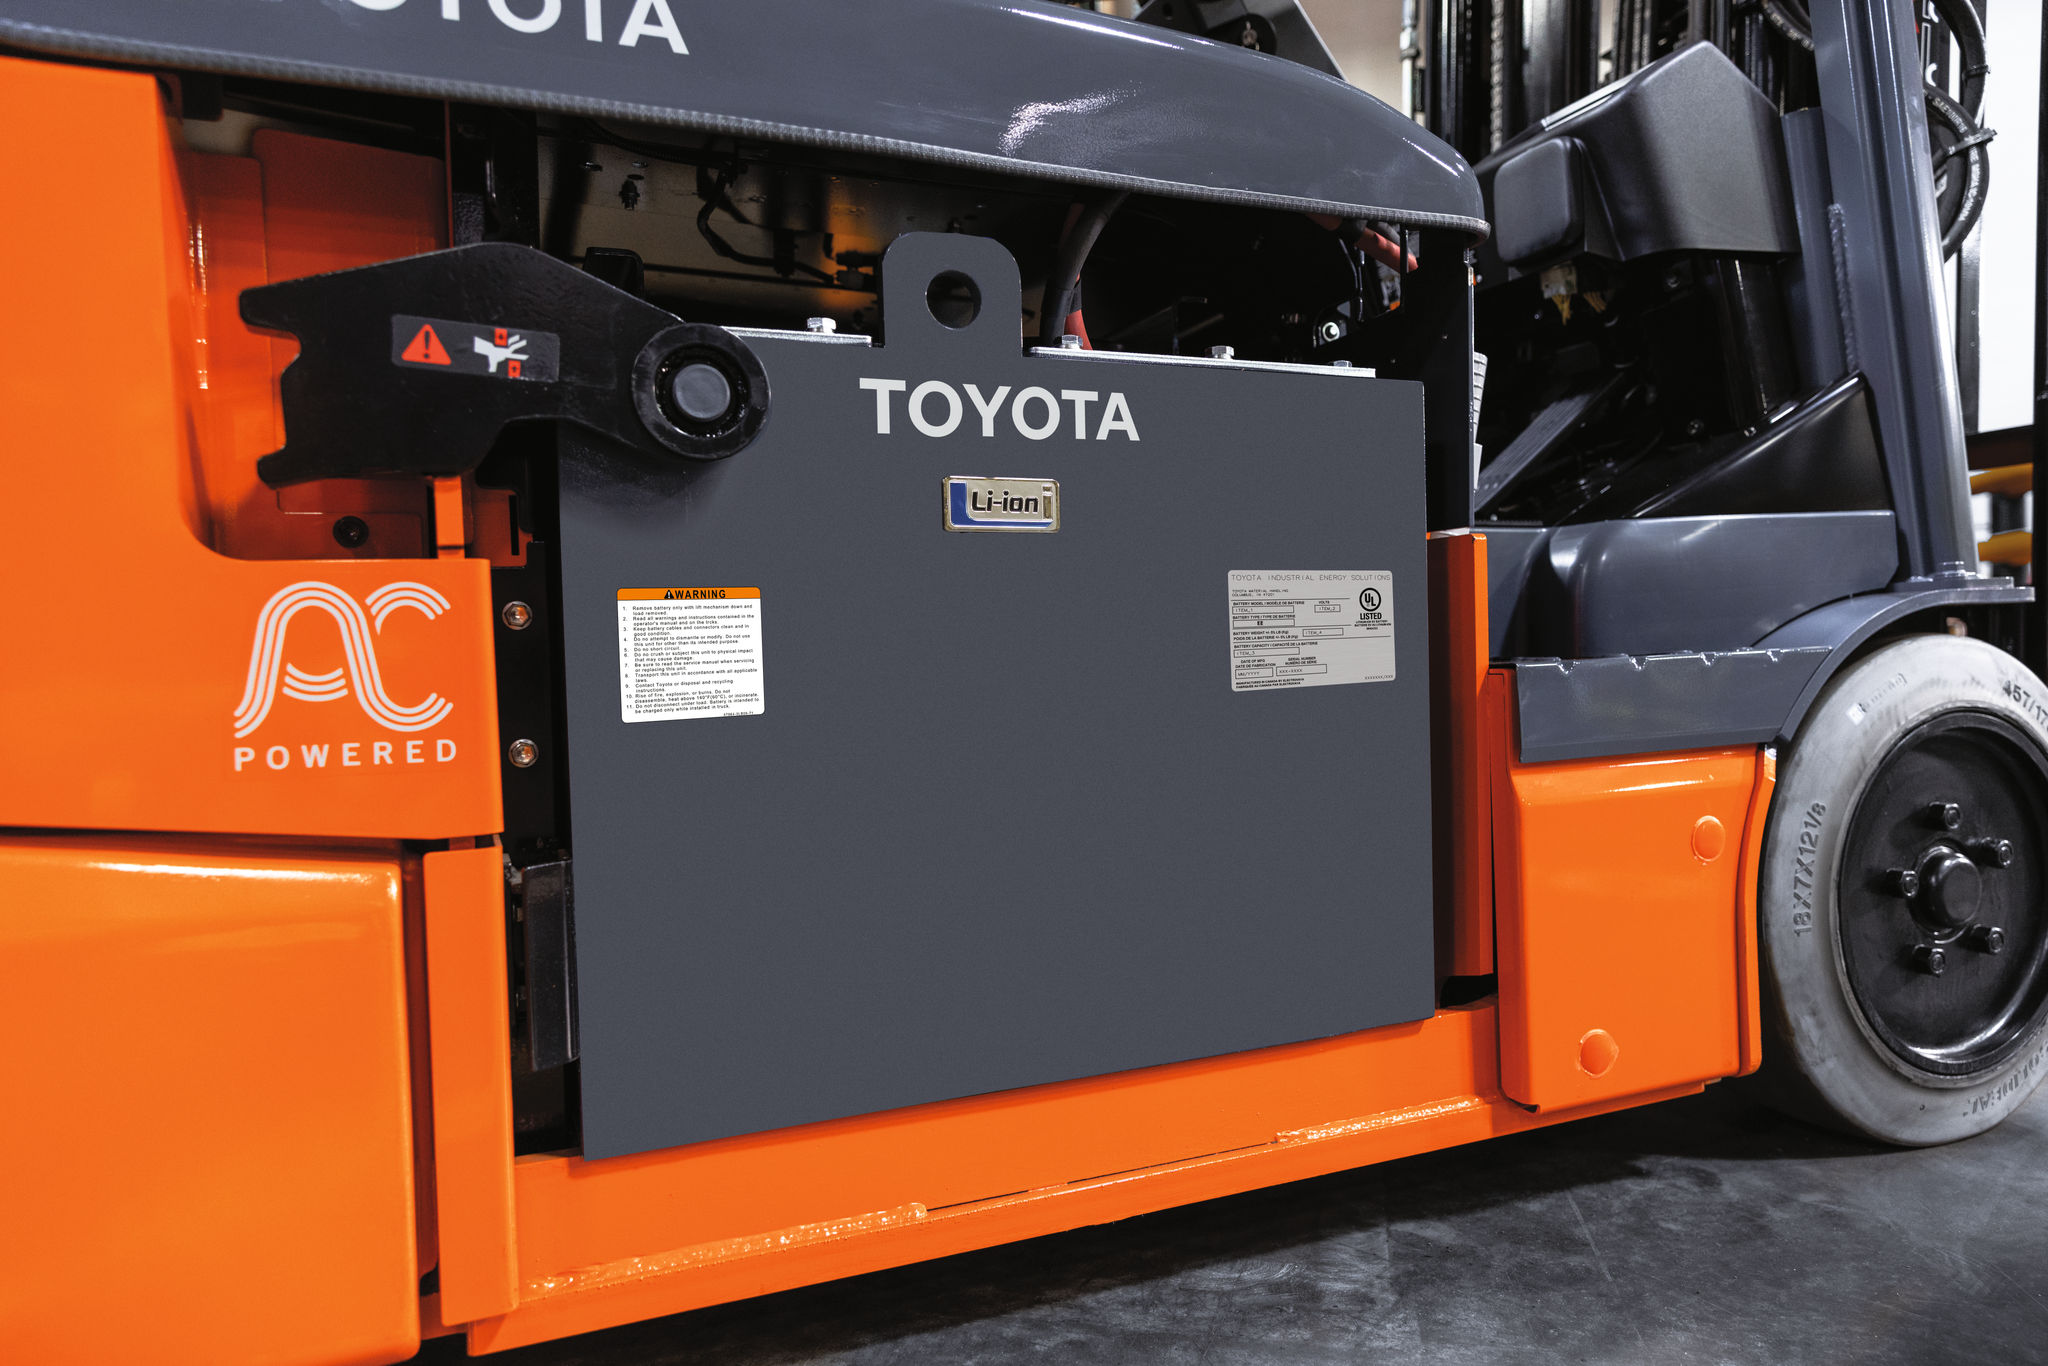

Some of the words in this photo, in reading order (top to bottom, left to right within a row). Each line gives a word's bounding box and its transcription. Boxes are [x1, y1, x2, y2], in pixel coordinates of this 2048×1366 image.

[859, 377, 1141, 441] TOYOTA
[972, 488, 1039, 512] Li-ion
[1231, 573, 1261, 581] TOYOTA
[1267, 573, 1315, 581] INDUSTRIAL
[1350, 573, 1390, 581] SOLUTIONS
[675, 589, 726, 600] WARNING
[1359, 611, 1382, 620] LISTED
[234, 581, 454, 738] AC
[2002, 680, 2048, 732] 457/17
[234, 739, 457, 772] POWERED
